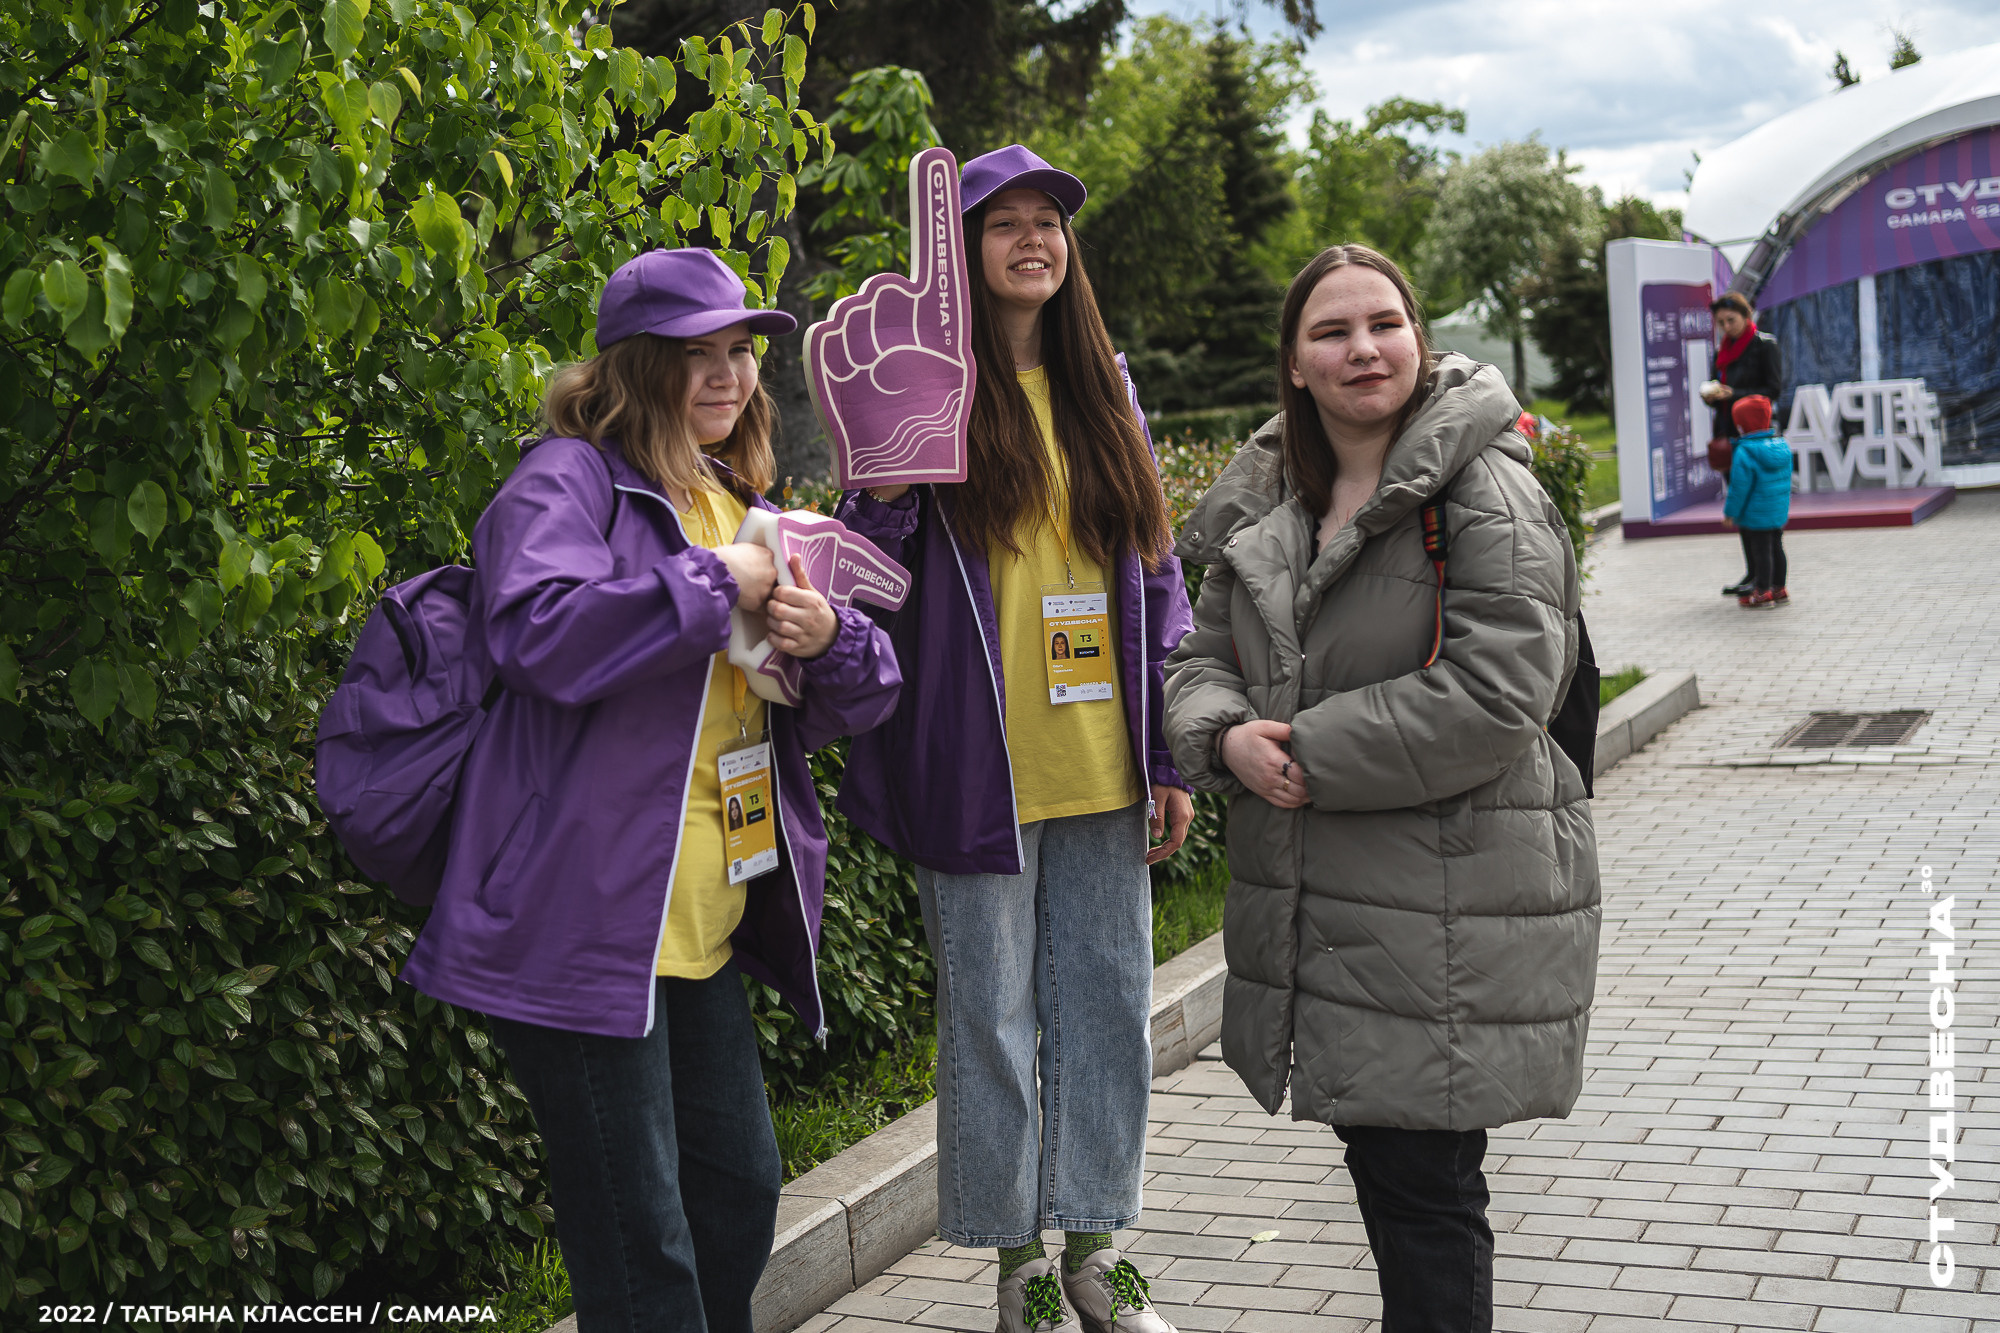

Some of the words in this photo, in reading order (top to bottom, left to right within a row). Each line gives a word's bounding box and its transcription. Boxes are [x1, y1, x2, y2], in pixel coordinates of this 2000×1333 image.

[1887, 207, 1966, 229] САМАРА
[932, 171, 950, 327] СТУДВЕСНА
[838, 557, 895, 593] СТУДВЕСНА
